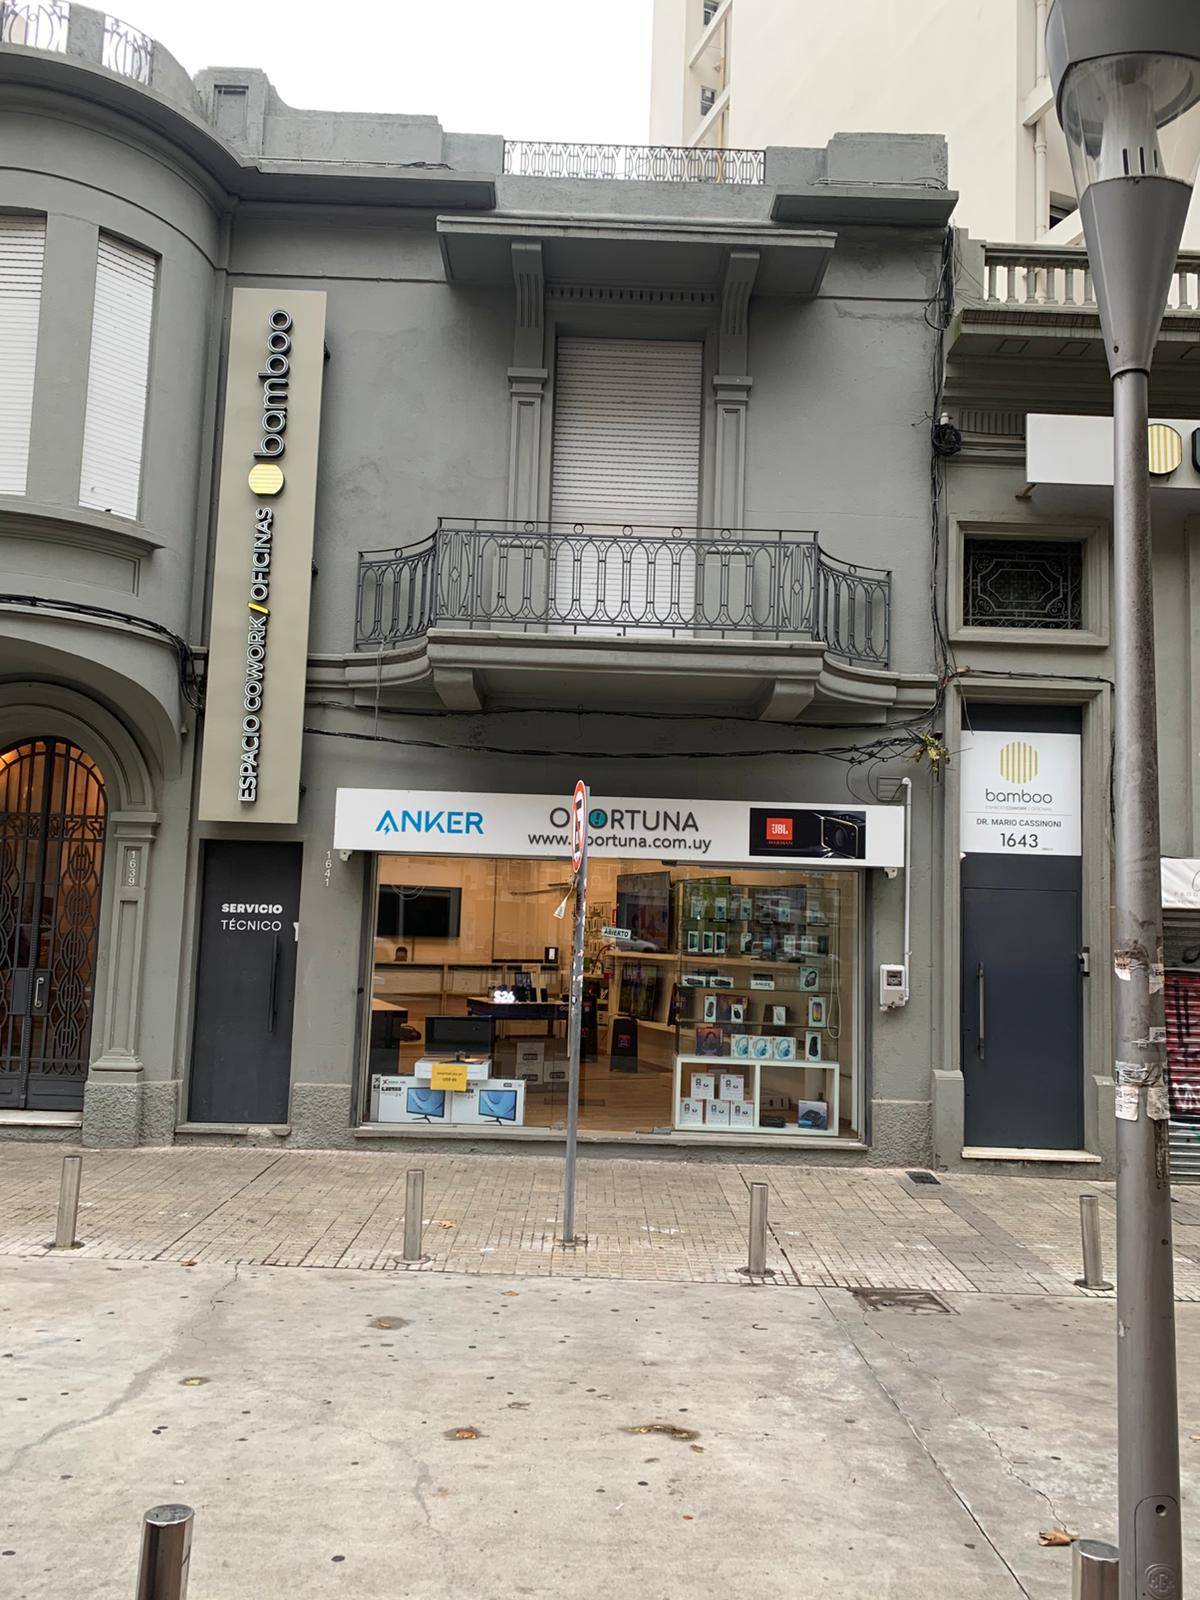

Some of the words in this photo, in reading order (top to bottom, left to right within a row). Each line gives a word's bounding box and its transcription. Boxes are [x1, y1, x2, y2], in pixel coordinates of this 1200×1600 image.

[253, 309, 292, 458] bamboo
[250, 507, 273, 601] OFICINAS
[244, 615, 268, 713] COWORK
[238, 715, 261, 802] ESPACIO
[985, 788, 1052, 804] bamboo
[375, 809, 484, 835] ANKER
[550, 807, 699, 832] OORTUNA
[771, 823, 788, 835] JBL
[976, 817, 989, 826] DR.
[991, 818, 1017, 827] MARIO
[1019, 819, 1062, 828] CASSINONI
[528, 833, 711, 854] www.ortuna.com.uy
[1000, 832, 1038, 848] 1643
[128, 850, 137, 887] 1639
[324, 850, 332, 887] 1641
[221, 903, 283, 914] SERVICIO
[220, 918, 282, 931] TÉCNICO
[604, 927, 629, 938] ABIERTO
